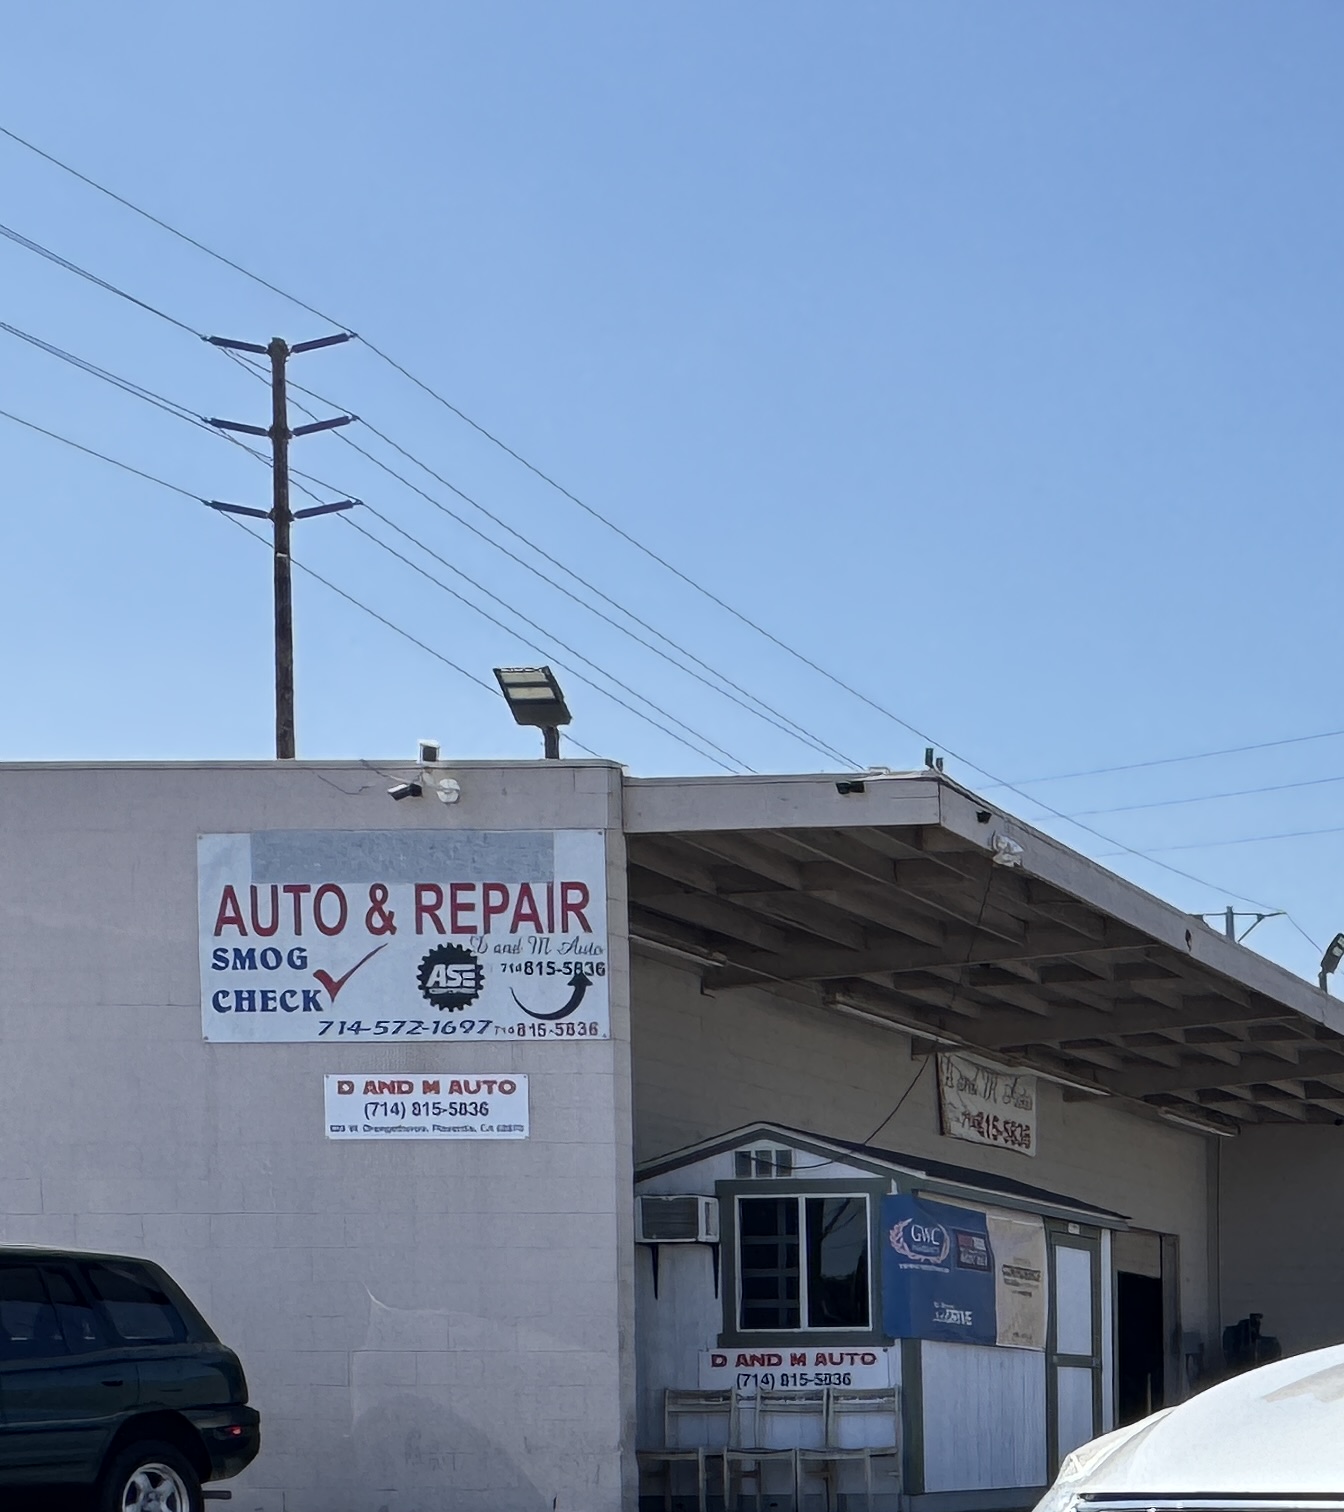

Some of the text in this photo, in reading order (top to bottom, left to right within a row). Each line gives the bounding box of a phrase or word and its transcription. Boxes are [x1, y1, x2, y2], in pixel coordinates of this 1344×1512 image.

[213, 881, 593, 937] AUTO & REPAIR
[494, 936, 523, 955] and
[528, 935, 552, 955] M
[556, 935, 604, 956] Auto
[211, 947, 308, 971] SMOG
[426, 964, 476, 988] ASE
[211, 989, 324, 1013] CHECK
[318, 1020, 493, 1036] 714-572-1697
[337, 1079, 517, 1095] D AND M AUTO
[364, 1101, 406, 1120] (714)
[711, 1352, 877, 1368] D AND M AUTO
